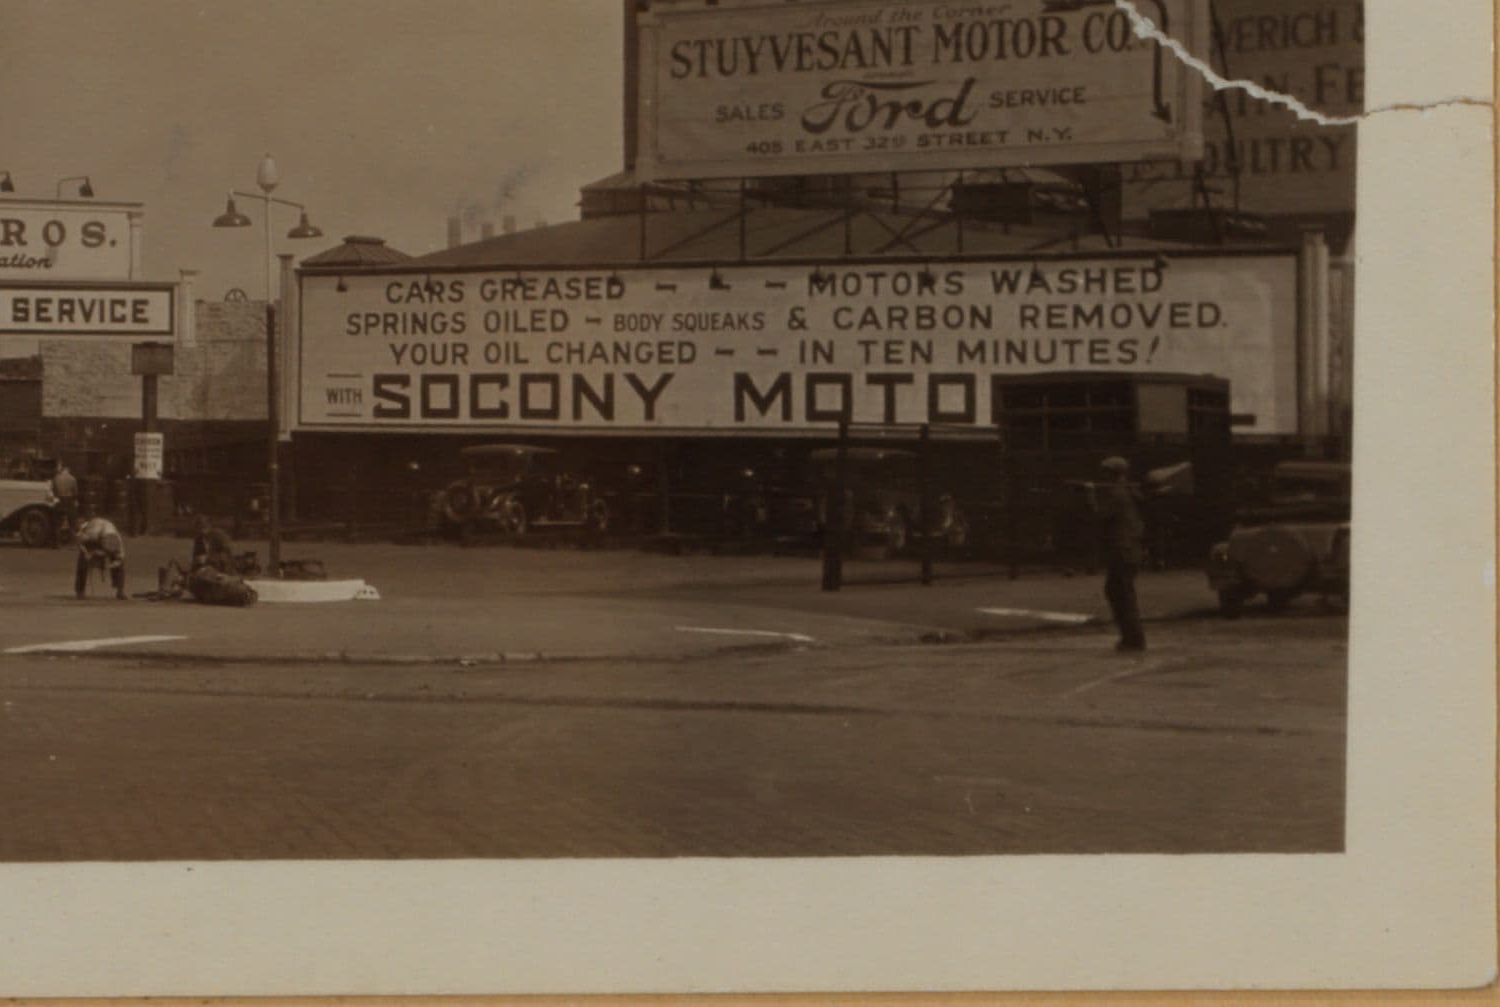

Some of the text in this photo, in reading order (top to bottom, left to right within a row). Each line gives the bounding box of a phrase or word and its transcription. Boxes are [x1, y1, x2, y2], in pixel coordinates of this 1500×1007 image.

[669, 9, 1134, 80] STUYVESANT MOTOR CO.
[715, 76, 1086, 134] SALES Ford SERVICE
[795, 138, 853, 153] EAST
[916, 130, 1010, 148] STREET
[386, 279, 464, 304] CARS
[480, 276, 625, 302] GREASED
[808, 271, 964, 297] MOTORS
[991, 265, 1164, 294] WASHED
[12, 296, 150, 325] SERVICE
[346, 312, 466, 336] SPRINGS
[484, 308, 569, 334] OILED
[614, 312, 664, 332] BODY
[672, 311, 766, 332] SQUEAKS
[786, 306, 809, 331] &
[833, 304, 993, 331] CARBON
[1020, 301, 1228, 329] REMOVED.
[389, 342, 469, 366] YOUR
[484, 342, 529, 365] OIL
[546, 340, 697, 365] CHANGED
[800, 340, 834, 365] IN
[858, 340, 934, 365] TEN
[957, 335, 1160, 365] MINUTES!
[326, 387, 363, 406] WITH
[373, 373, 674, 422] SOCONY
